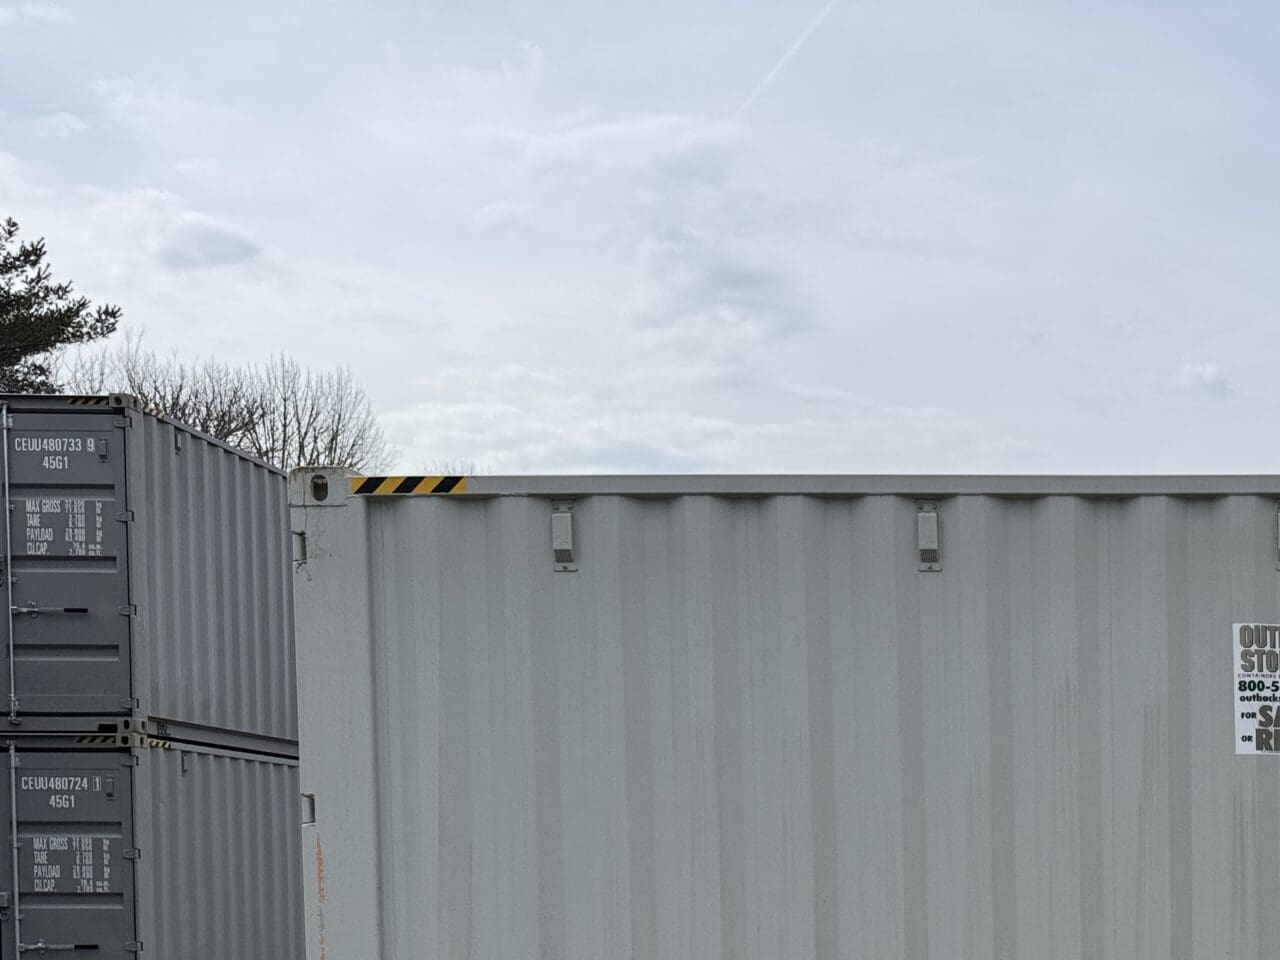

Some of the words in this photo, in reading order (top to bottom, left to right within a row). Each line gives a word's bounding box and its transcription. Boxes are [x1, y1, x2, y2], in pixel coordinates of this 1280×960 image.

[15, 437, 82, 451] CEUU480733
[86, 438, 95, 451] 9
[42, 456, 69, 469] 45G1
[25, 500, 40, 513] MAX
[26, 513, 40, 526] TARE
[26, 528, 54, 541] PAYLOAD
[21, 776, 88, 790] CEUU480724
[49, 795, 75, 808] 45G1
